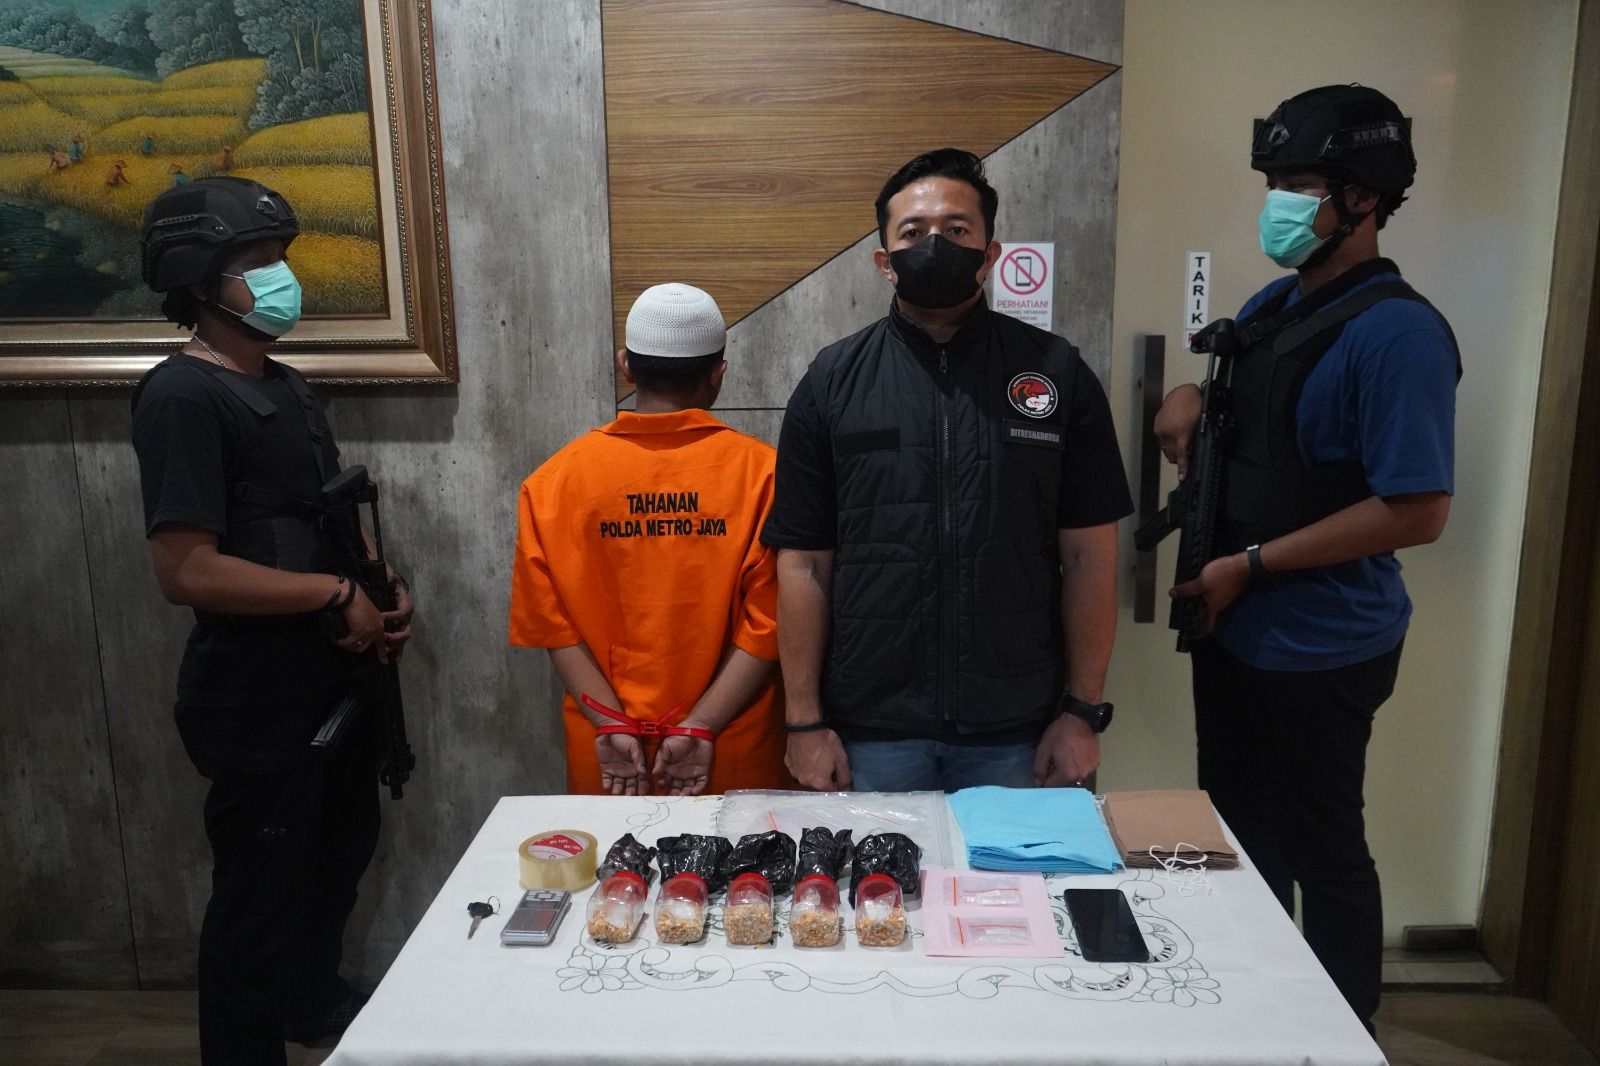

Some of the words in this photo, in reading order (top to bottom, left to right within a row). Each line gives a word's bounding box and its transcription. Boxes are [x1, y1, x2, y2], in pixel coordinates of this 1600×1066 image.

[1191, 256, 1206, 324] TARIK
[996, 299, 1049, 309] PERHATIAN!
[626, 491, 699, 514] TAHANAN
[600, 519, 643, 538] POLDA
[646, 518, 693, 537] METRO
[696, 518, 727, 536] JAYA
